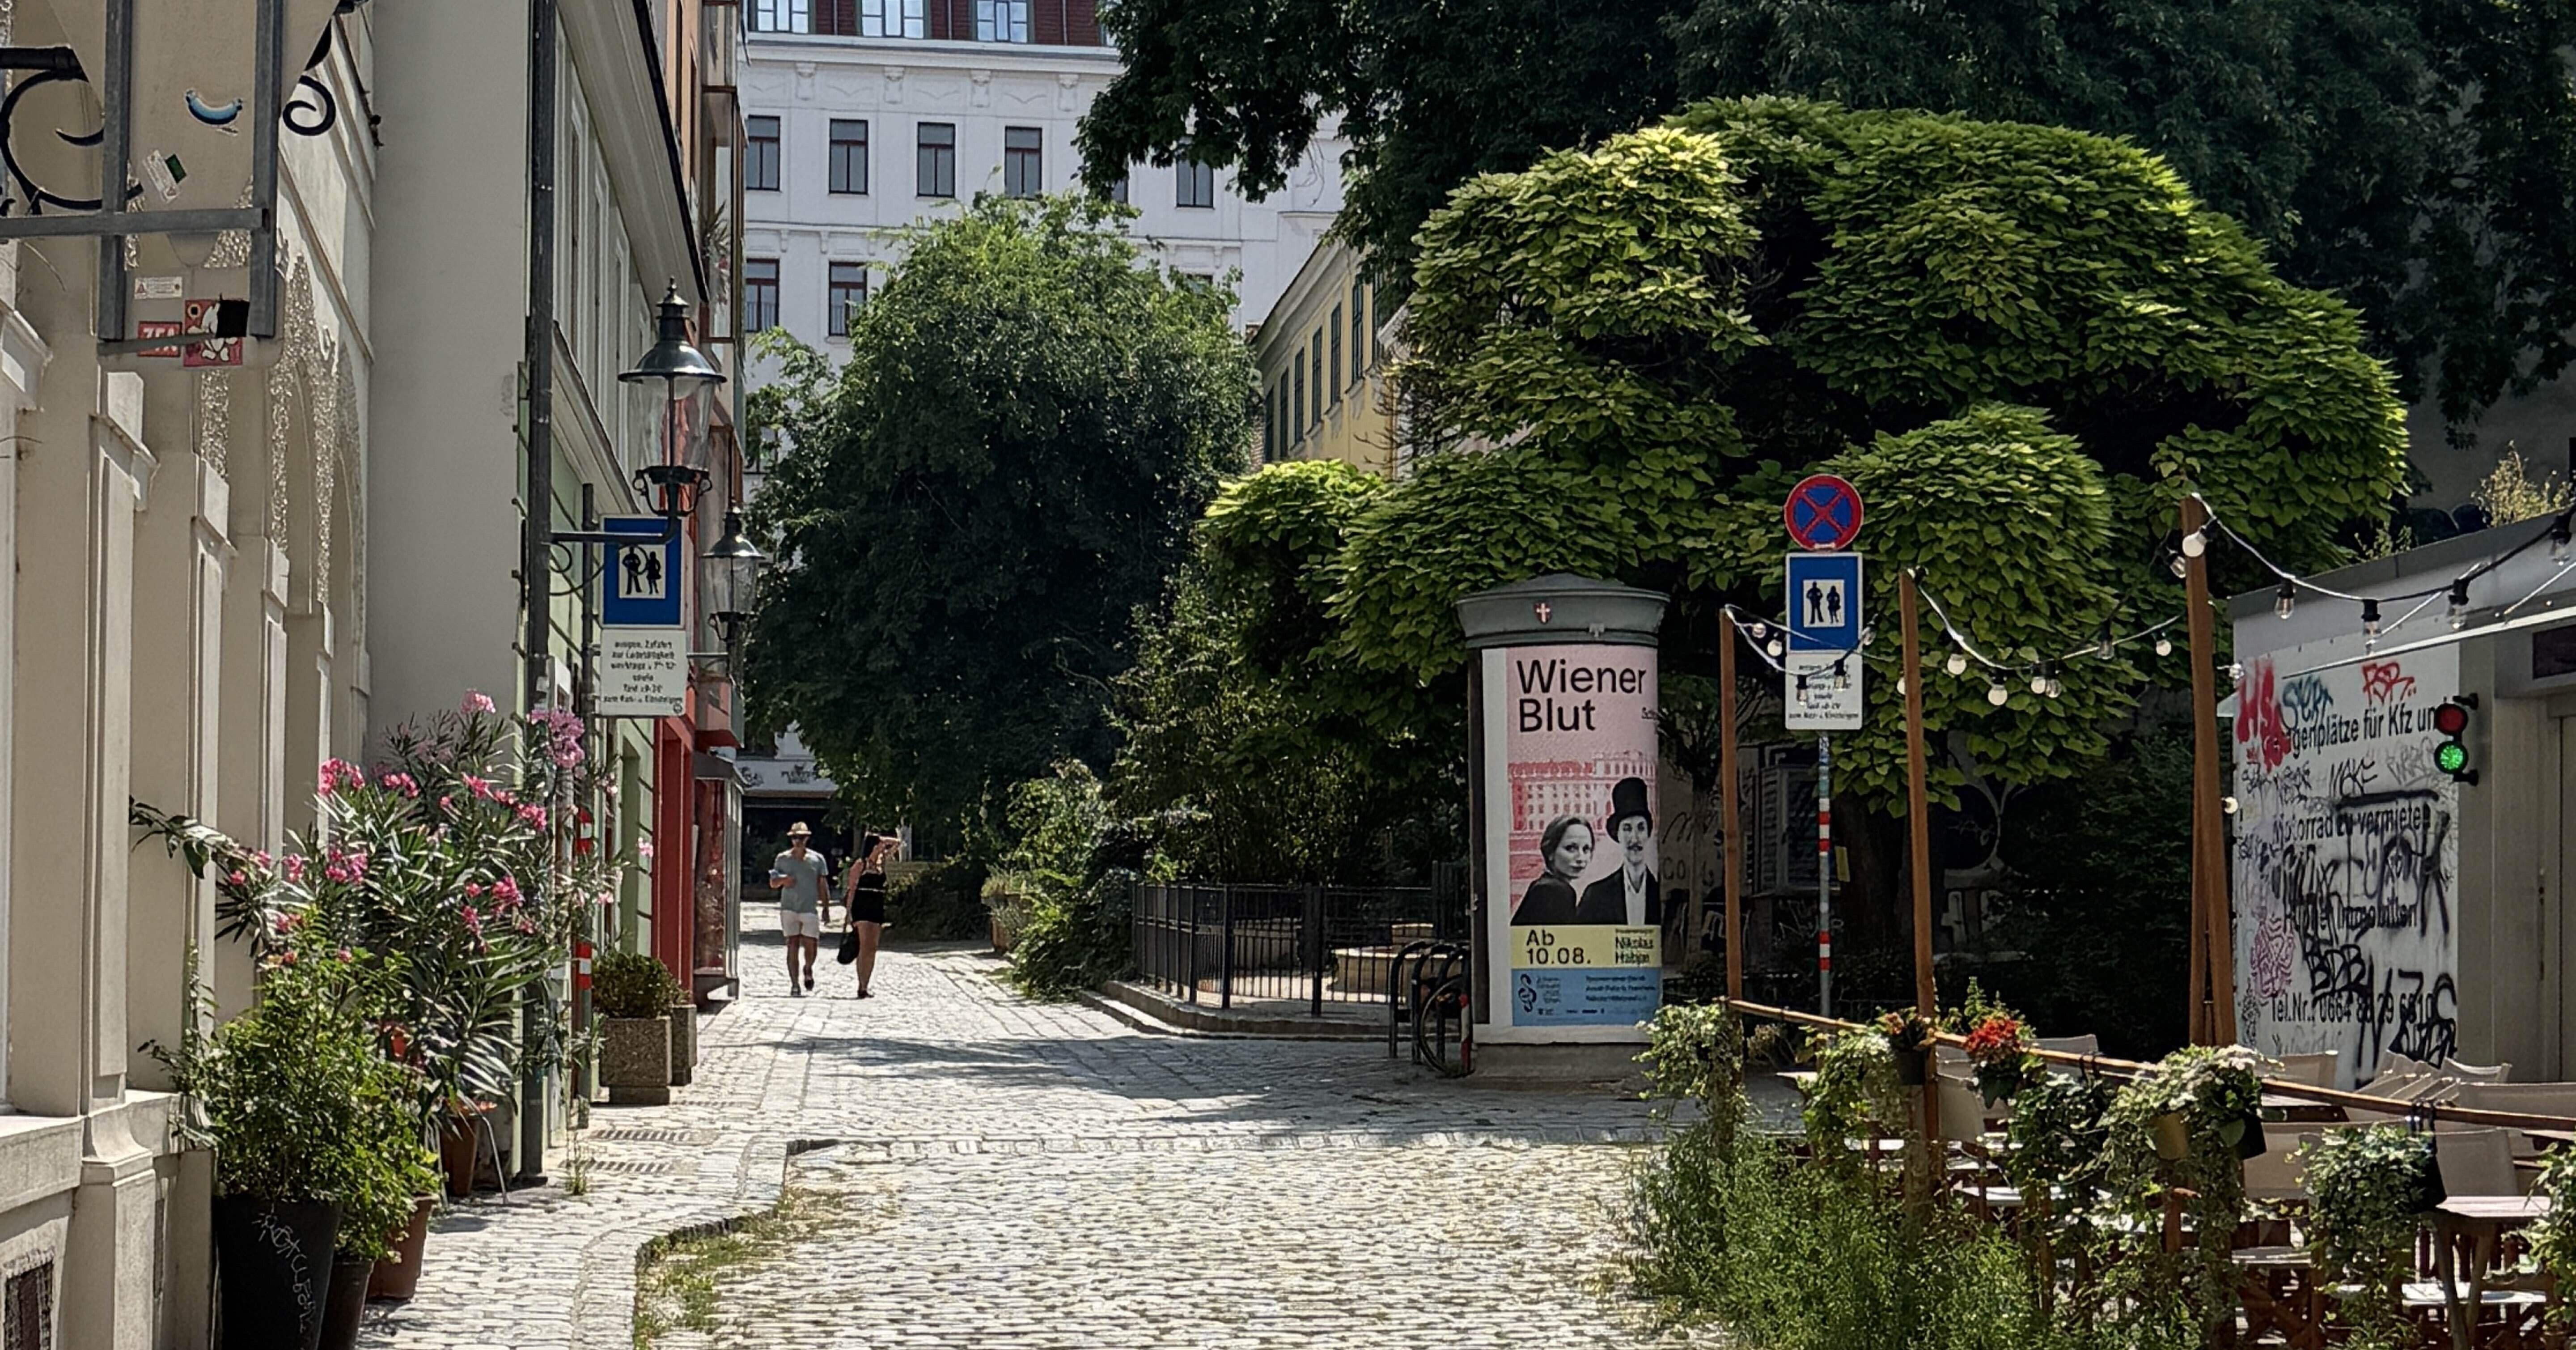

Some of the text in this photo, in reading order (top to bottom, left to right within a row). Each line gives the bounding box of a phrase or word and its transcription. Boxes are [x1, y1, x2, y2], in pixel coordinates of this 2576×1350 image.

[1516, 658, 1647, 694] Wiener
[1519, 698, 1596, 733] Blut
[2287, 703, 2440, 760] genplätze für Kfz un
[2359, 803, 2430, 834] vermieten
[1526, 929, 1555, 946] Ab
[1526, 947, 1591, 964] 10.08.
[2319, 994, 2351, 1023] 0664
